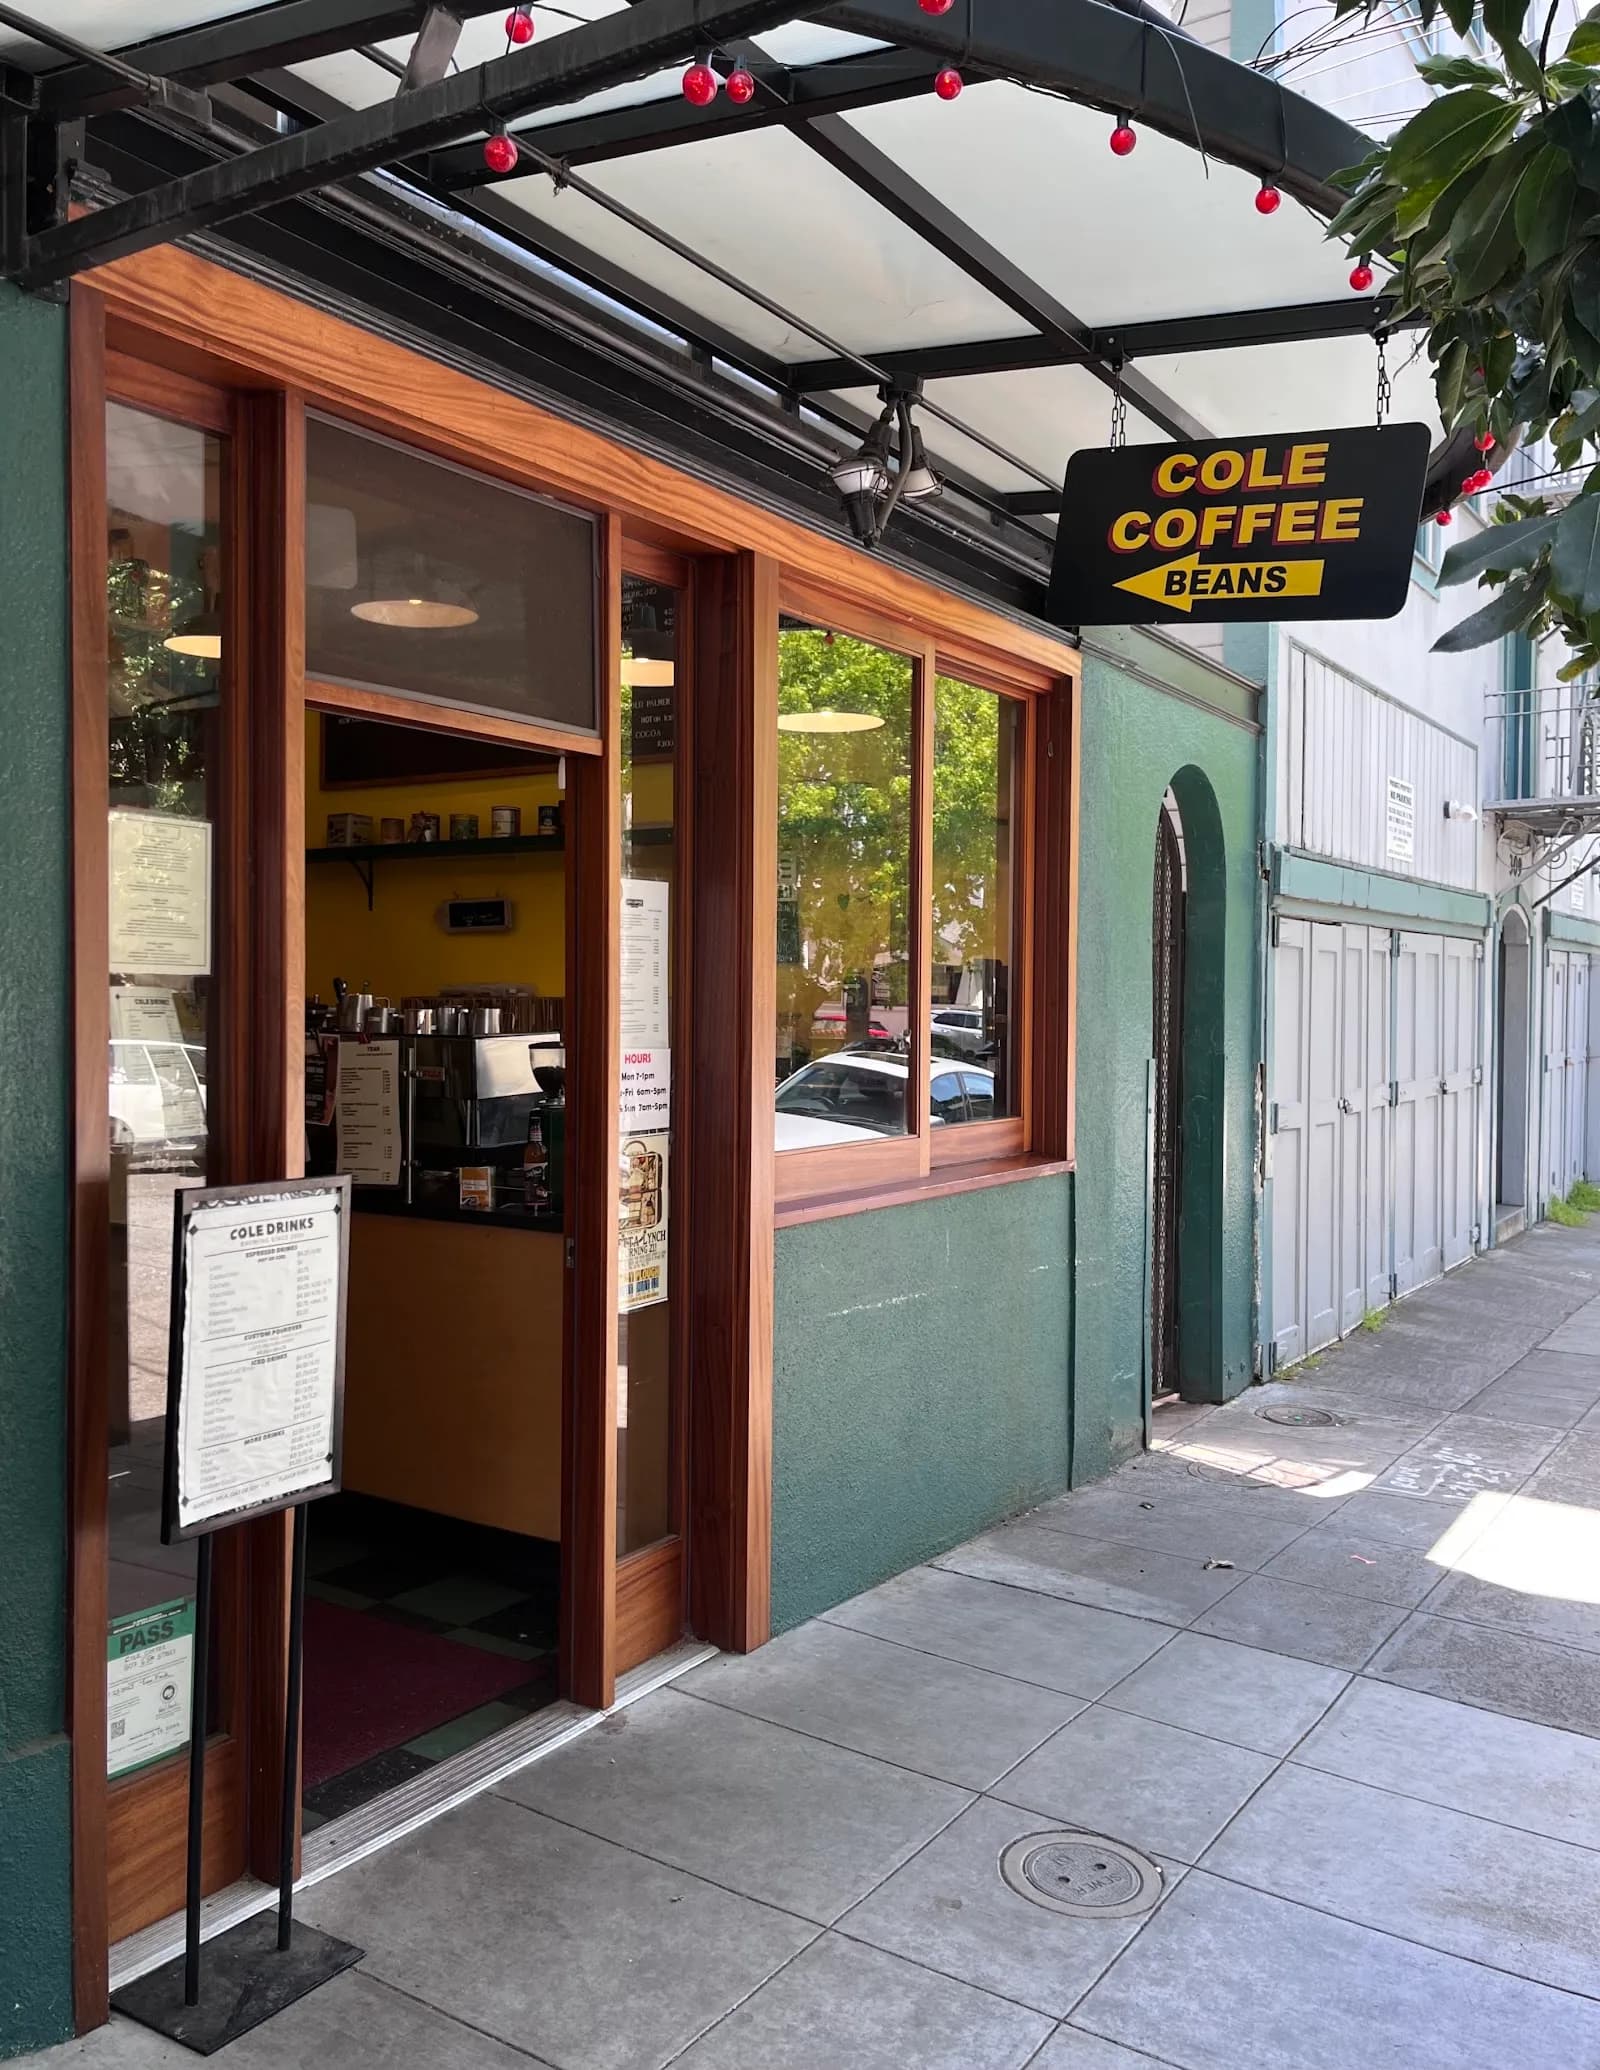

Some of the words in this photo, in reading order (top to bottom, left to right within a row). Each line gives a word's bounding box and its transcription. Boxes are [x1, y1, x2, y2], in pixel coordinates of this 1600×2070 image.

[1153, 443, 1330, 497] COLE
[1108, 498, 1364, 553] COFFEE
[1164, 565, 1288, 597] BEANS
[624, 1053, 651, 1064] HOURS
[621, 1072, 634, 1081] Mon
[636, 1072, 655, 1082] 7-1pm
[637, 1087, 667, 1096] 6am-5pm
[624, 1103, 636, 1112] Sun
[638, 1102, 668, 1112] 7am-5pm
[230, 1225, 264, 1240] COLE
[266, 1217, 314, 1235] DRINKS
[120, 1621, 174, 1654] PASS
